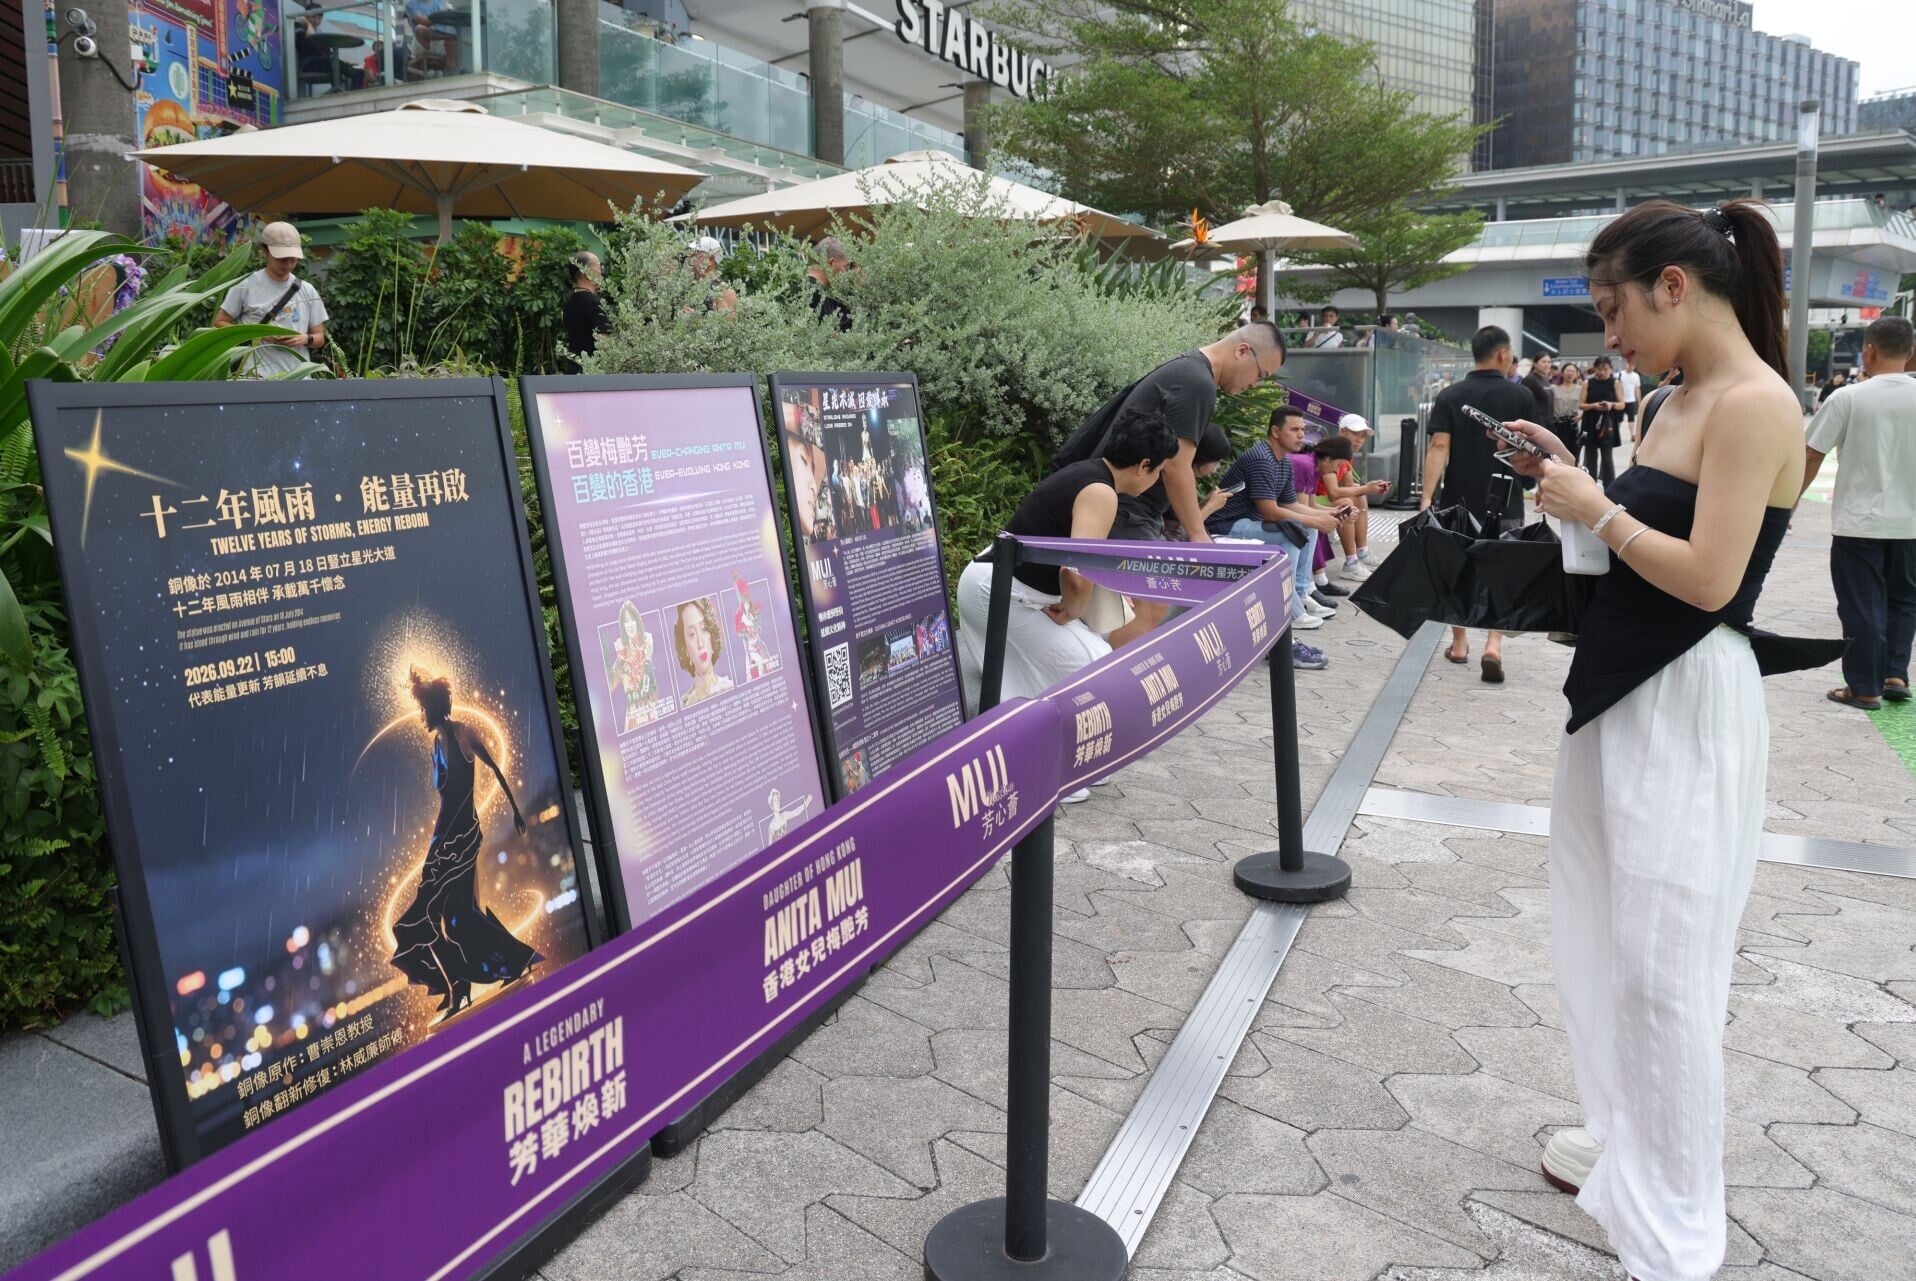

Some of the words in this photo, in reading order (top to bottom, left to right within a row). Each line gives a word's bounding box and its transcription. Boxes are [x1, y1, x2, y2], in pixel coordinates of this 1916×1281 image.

[566, 434, 649, 468] 百變梅艷芳
[651, 445, 710, 460] EVER-CHANGING
[712, 442, 731, 452] ANITA
[655, 464, 711, 480] EVER-EVOLVING
[713, 462, 730, 473] HONG
[733, 459, 750, 470] KONG
[571, 466, 654, 504] 百變的香港
[139, 481, 316, 539] 十二年風雨
[210, 534, 256, 556] TWELVE
[257, 528, 292, 549] YEARS
[294, 527, 307, 544] OF
[310, 522, 356, 542] STORMS,
[356, 516, 392, 536] ENERGY
[394, 511, 429, 531] REBORN
[168, 572, 212, 595] 銅像於
[214, 568, 247, 587] 2014
[249, 565, 263, 581] 年
[265, 563, 280, 578] 07
[284, 560, 296, 576] 月
[299, 559, 314, 573] 18
[811, 557, 832, 581] MUI
[1116, 559, 1159, 573] AVENUE
[1160, 562, 1176, 574] OF
[172, 587, 270, 619] 十二年風雨相伴
[272, 574, 346, 601] 承載萬千懷念
[264, 646, 296, 669] 15:00
[1193, 621, 1224, 665] MUI
[188, 678, 261, 709] 代表能量更新
[1075, 701, 1112, 744] REBIRTH
[946, 743, 1009, 829] MUI
[763, 871, 803, 911] DAUGHTER
[804, 863, 814, 883] OF
[815, 849, 836, 876] HONG
[835, 836, 856, 862] KONG
[764, 886, 823, 968] ANITA
[825, 857, 864, 922] MUI
[762, 904, 869, 1004] 香港女兒梅艷芳
[523, 1041, 532, 1065] A
[535, 997, 604, 1057] LEGENDARY
[503, 1015, 624, 1143] REBIRTH
[508, 1069, 627, 1187] 芳華煥新
